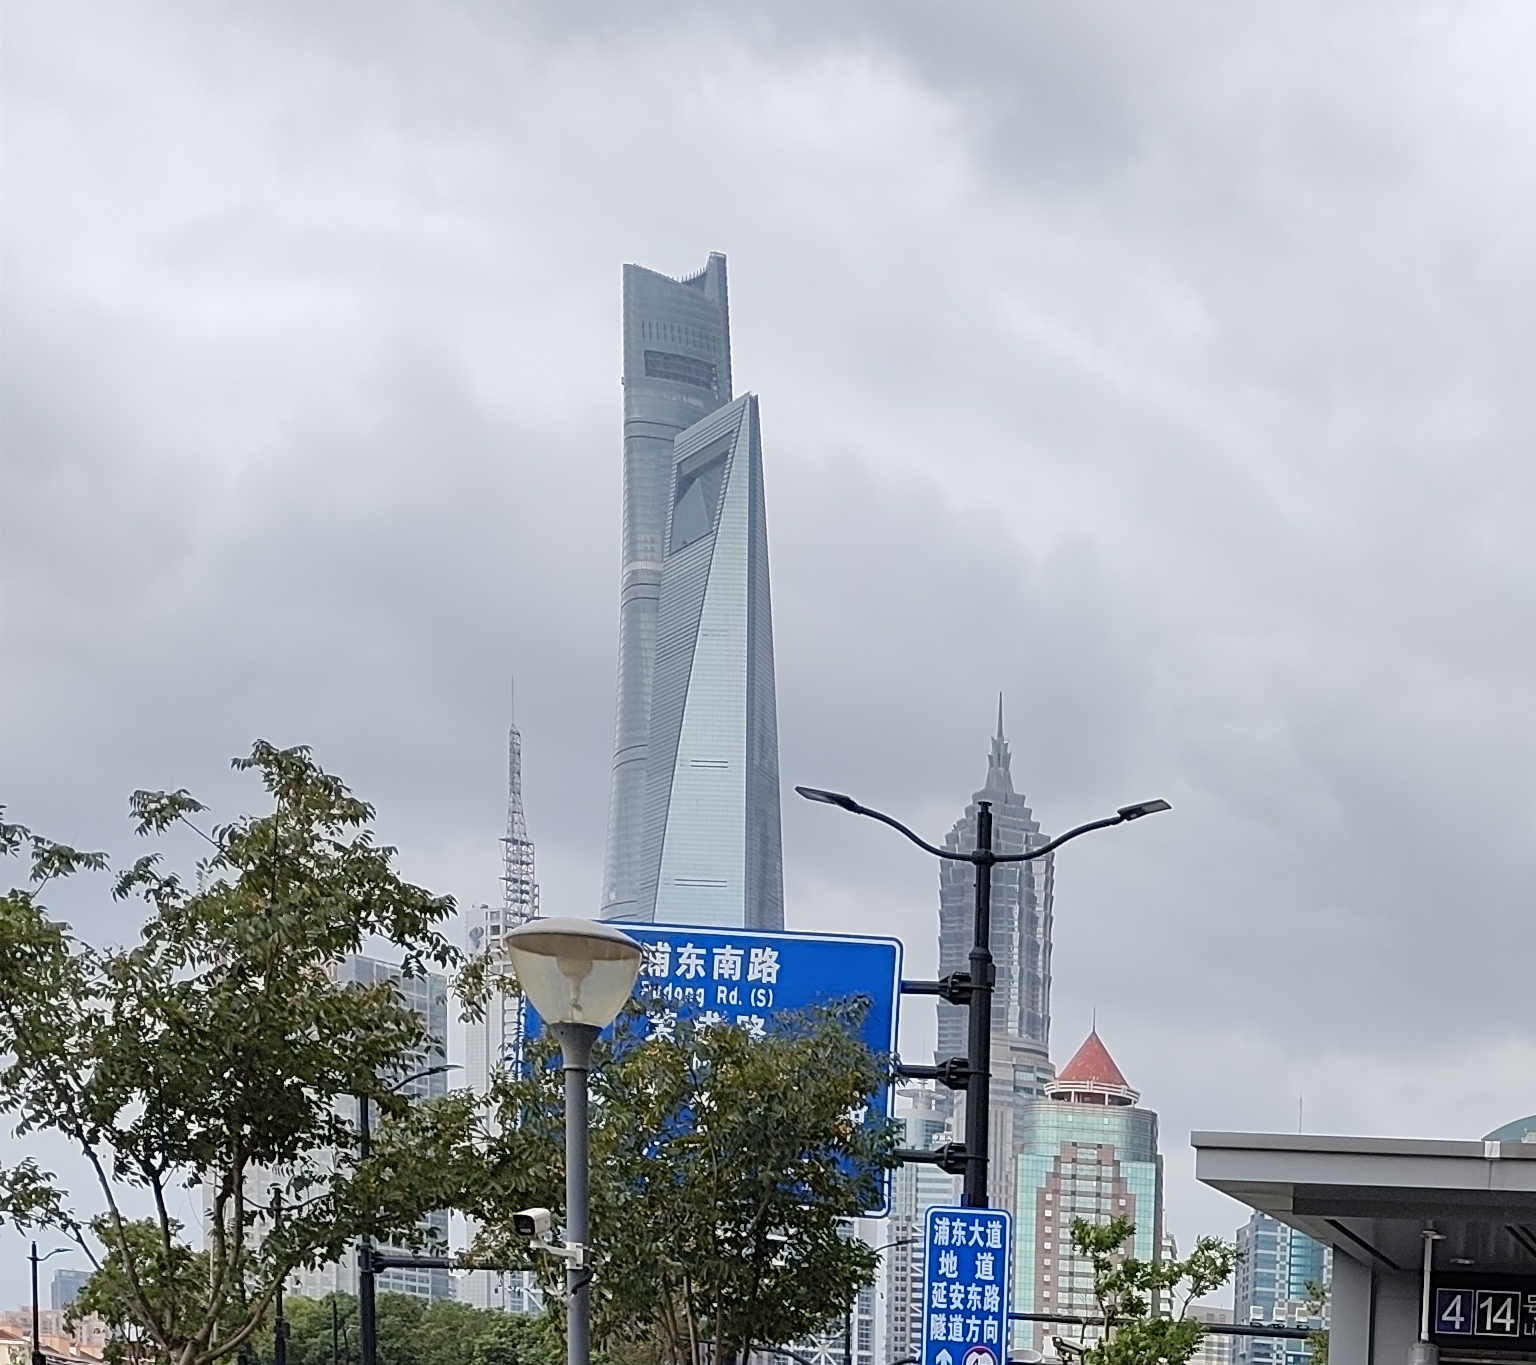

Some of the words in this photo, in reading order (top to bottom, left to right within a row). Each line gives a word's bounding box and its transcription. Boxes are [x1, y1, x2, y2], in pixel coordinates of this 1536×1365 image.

[638, 941, 781, 985] 浦东南路
[717, 985, 743, 1006] Rd.
[750, 988, 774, 1008] (S)
[932, 1216, 1003, 1249] 浦东大道
[931, 1281, 1001, 1313] 延安东路
[1440, 1294, 1465, 1330] 4
[1479, 1296, 1516, 1332] 14
[929, 1313, 1000, 1345] 隧道方向
